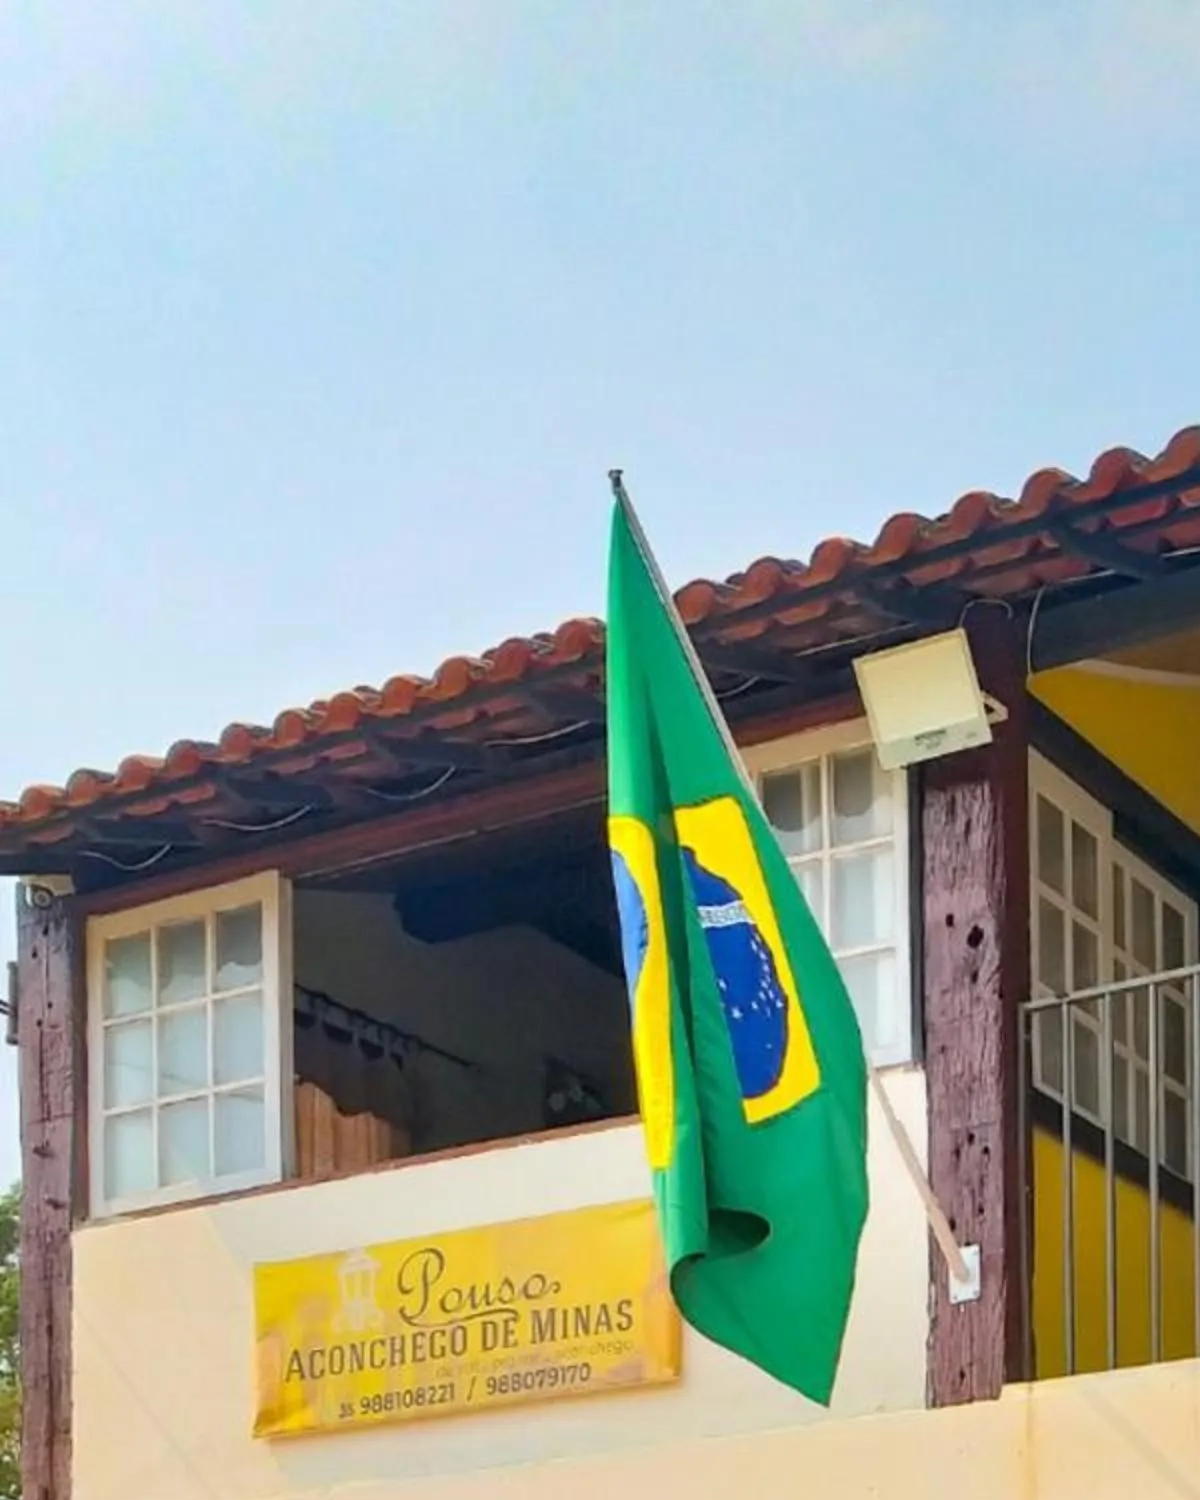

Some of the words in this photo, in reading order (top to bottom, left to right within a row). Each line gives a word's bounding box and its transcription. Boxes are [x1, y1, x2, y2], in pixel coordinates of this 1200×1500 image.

[397, 1247, 562, 1328] Pouso
[285, 1325, 468, 1383] ACONCHEGO
[480, 1317, 519, 1351] DE
[530, 1298, 634, 1344] MINAS
[359, 1383, 455, 1415] 988108221
[486, 1362, 591, 1396] 988079170
